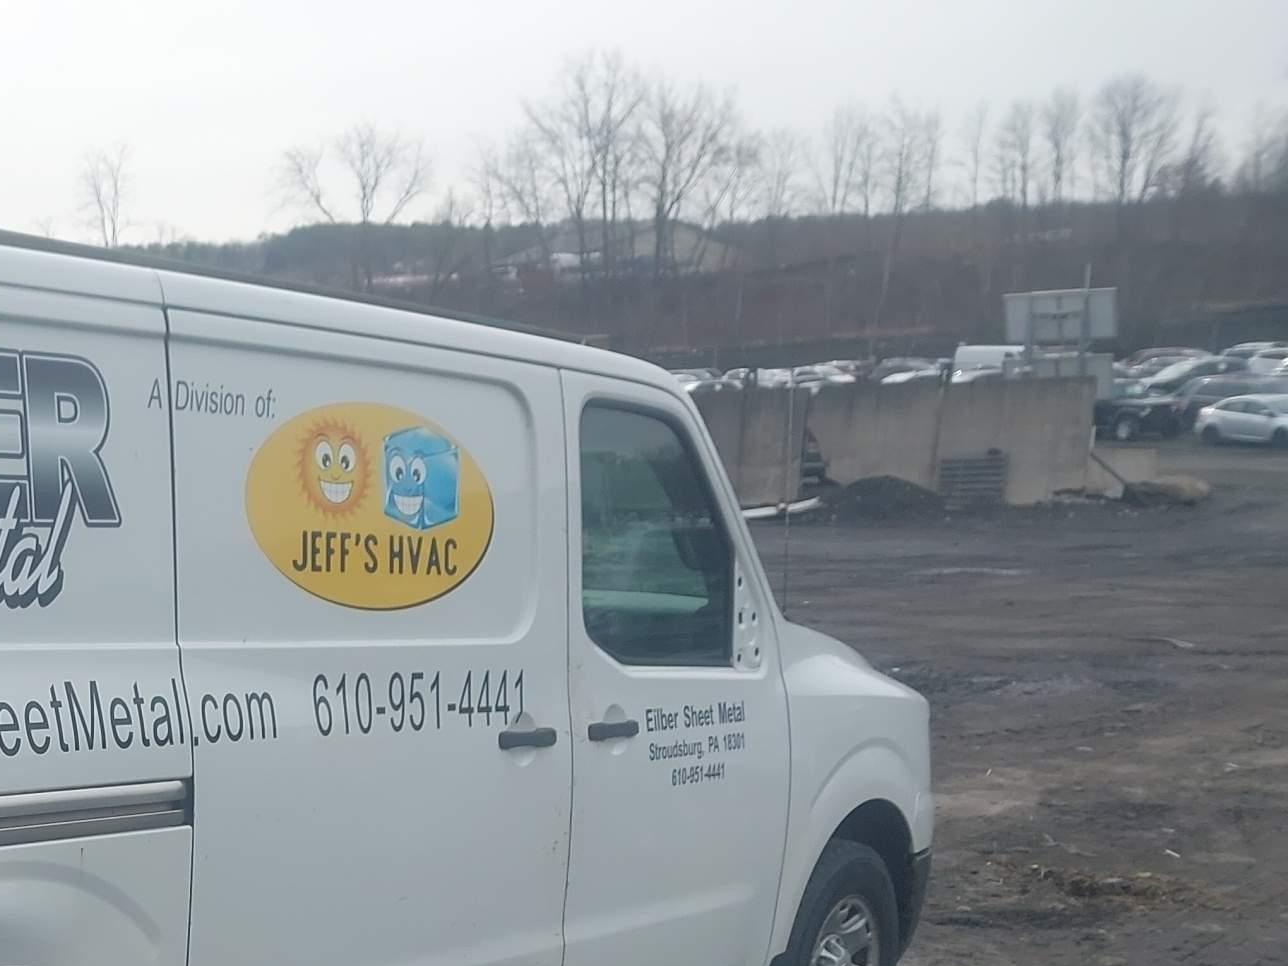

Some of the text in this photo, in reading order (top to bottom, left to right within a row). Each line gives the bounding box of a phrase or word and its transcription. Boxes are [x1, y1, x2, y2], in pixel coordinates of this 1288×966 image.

[147, 377, 276, 418] A Division of:
[292, 530, 458, 576] JEFF'S HVAC
[312, 669, 525, 736] 610-951-4441
[645, 700, 745, 732] Eilber Sheet Metal
[649, 740, 705, 761] Stroudsburg,
[708, 735, 720, 753] PA
[672, 762, 725, 786] 610-951-4441
